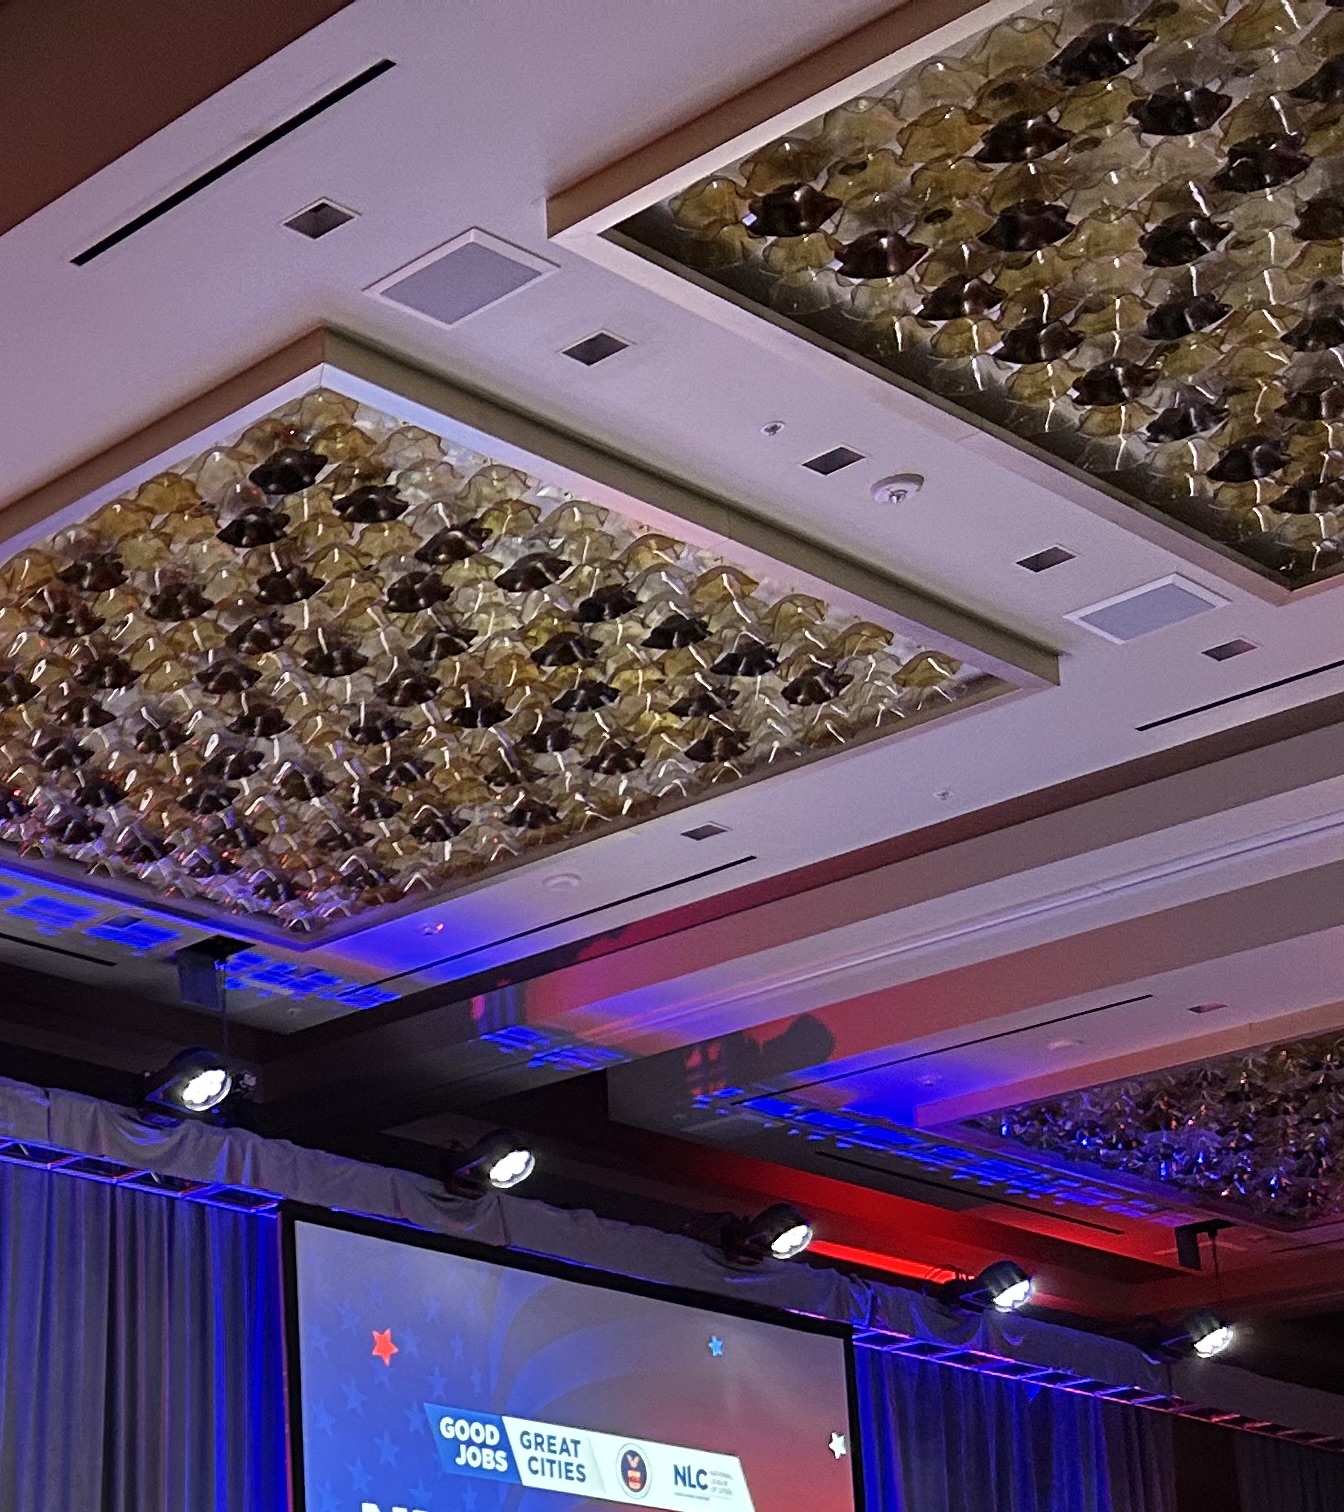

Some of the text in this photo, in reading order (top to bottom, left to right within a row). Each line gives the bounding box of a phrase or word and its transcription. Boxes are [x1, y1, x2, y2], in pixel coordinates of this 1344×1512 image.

[439, 1415, 500, 1447] GOOD
[519, 1430, 581, 1459] GREAT
[455, 1444, 508, 1473] JOBS
[527, 1456, 586, 1483] CITIES
[673, 1464, 709, 1491] NLC
